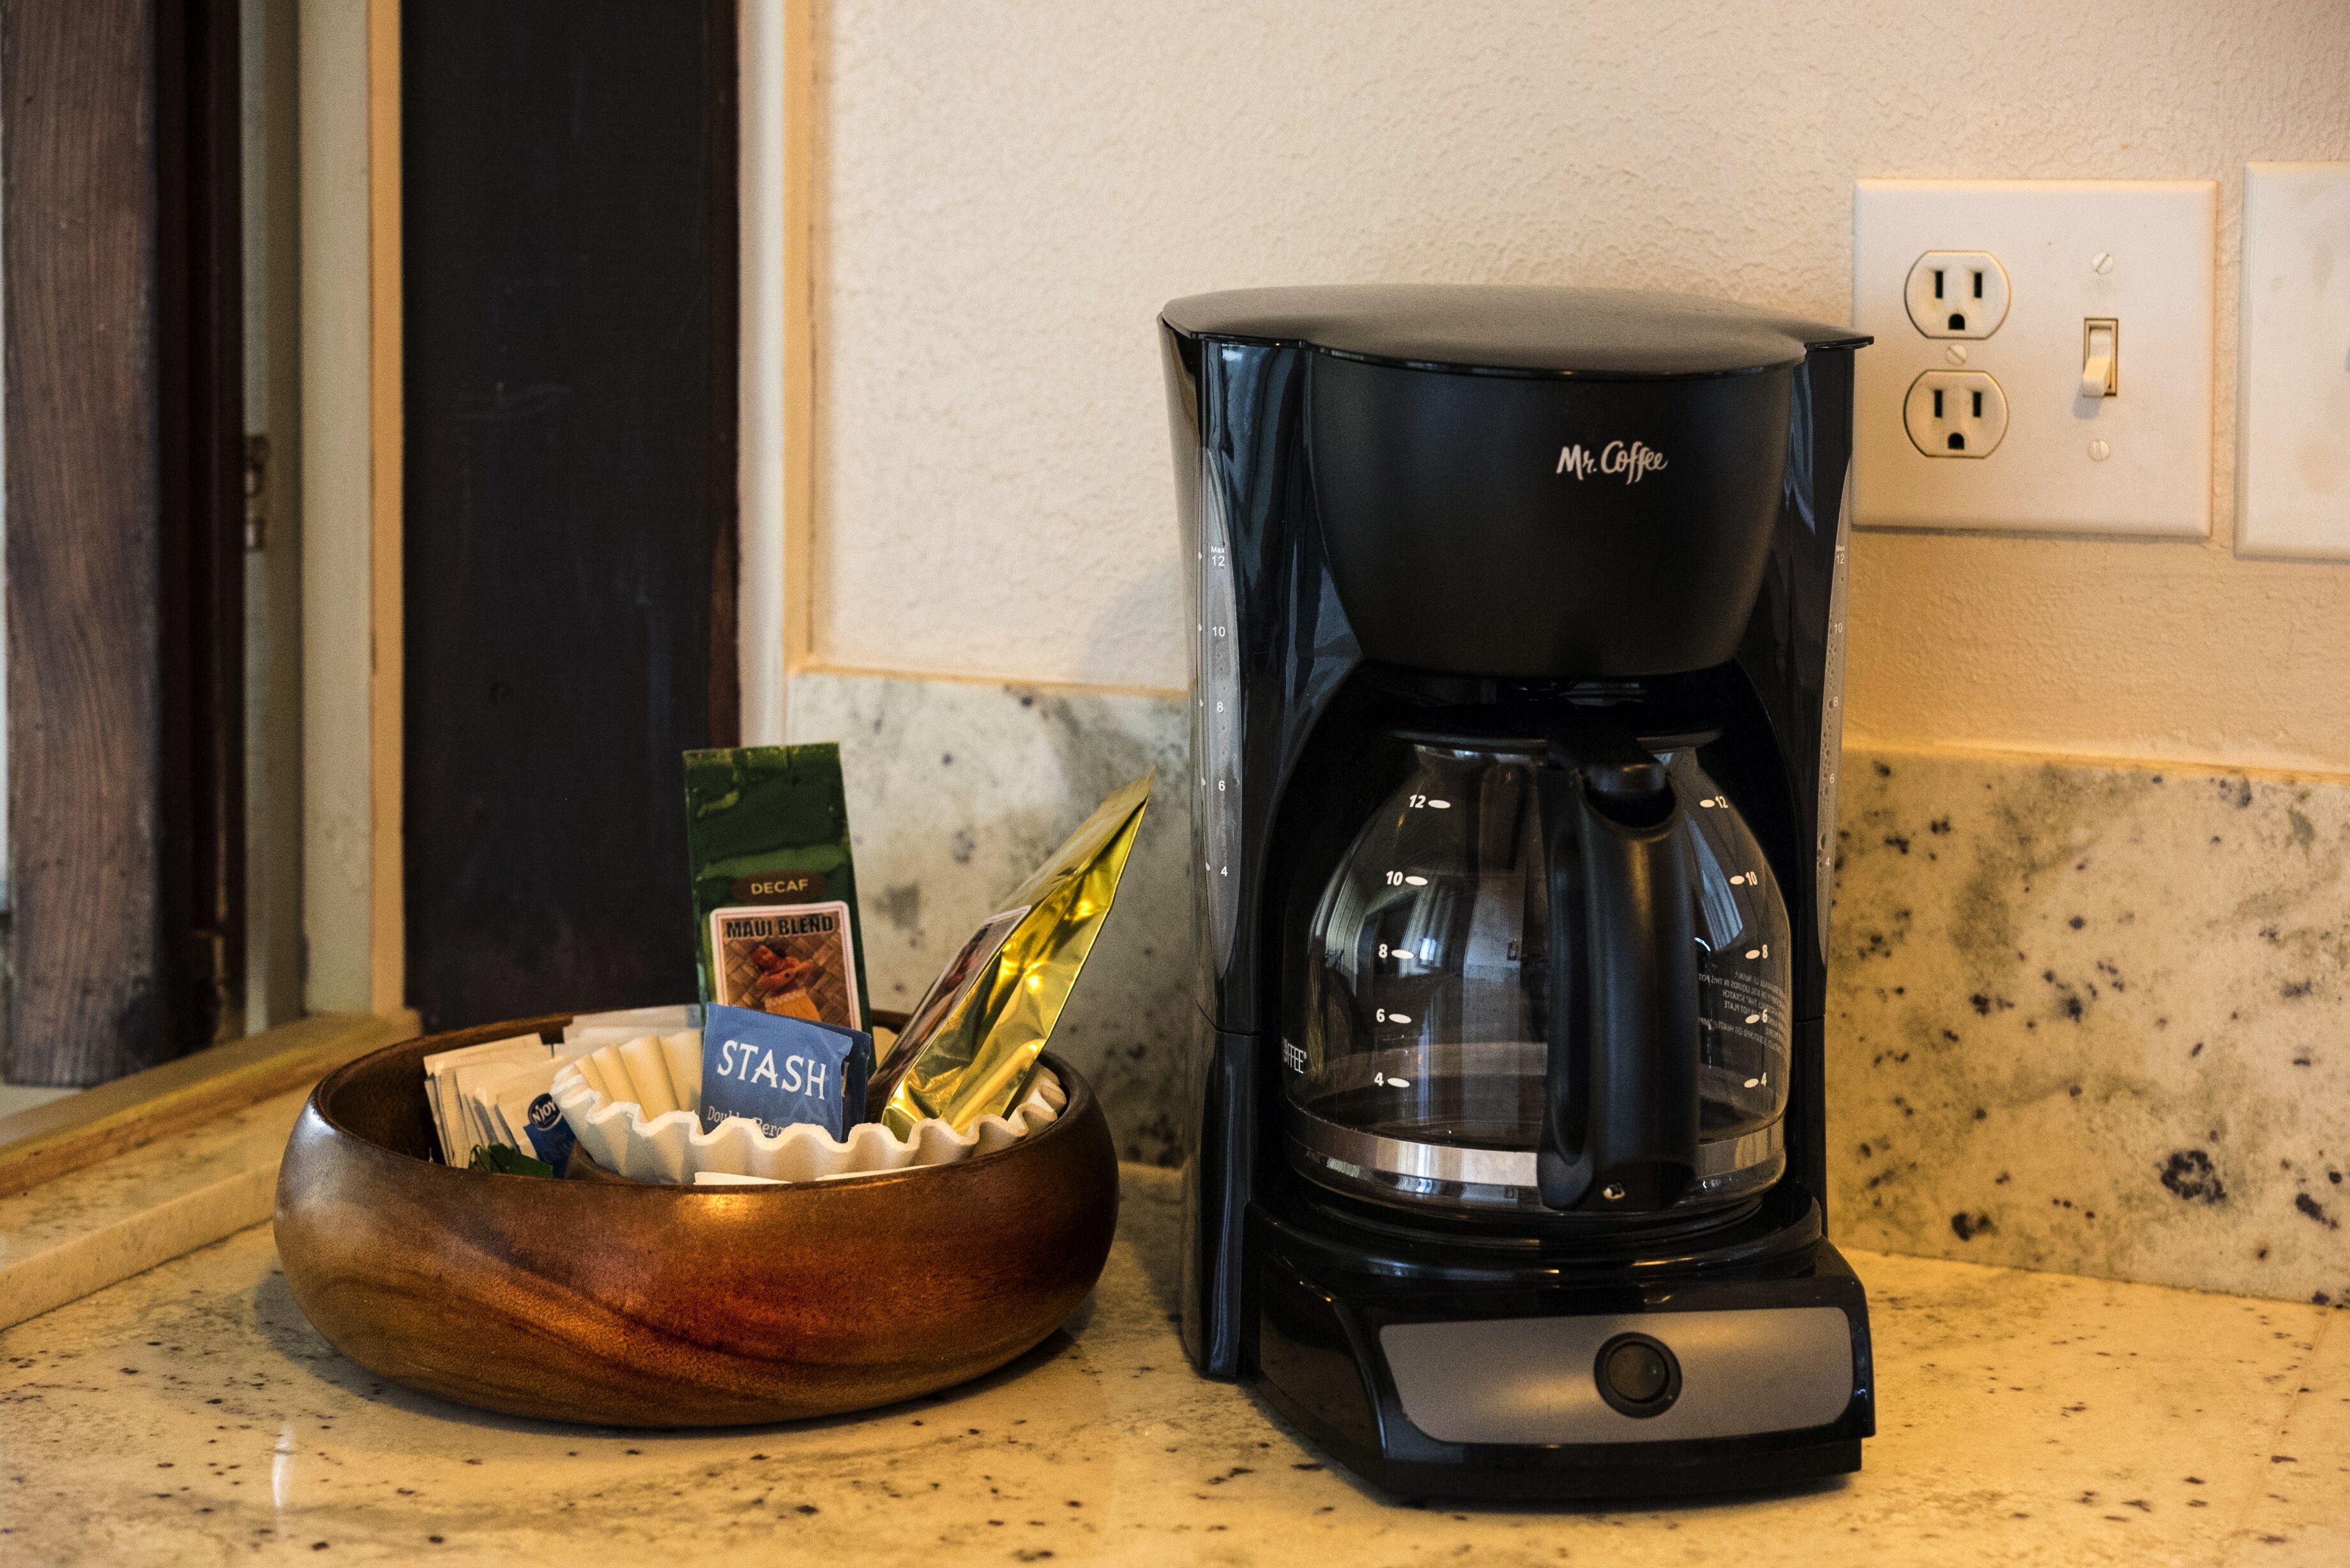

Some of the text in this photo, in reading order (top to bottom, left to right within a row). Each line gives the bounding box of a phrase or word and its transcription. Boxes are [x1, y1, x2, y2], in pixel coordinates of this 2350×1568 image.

[1556, 441, 1669, 485] Mr. Coffee
[1211, 555, 1225, 566] 12
[1837, 554, 1845, 564] 12
[1212, 626, 1225, 637] 10
[1835, 622, 1842, 633] 10
[1217, 702, 1224, 712] 8
[1833, 696, 1838, 707] 8
[1830, 773, 1835, 783] 6
[1218, 780, 1225, 791] 6
[1409, 794, 1427, 809] 12
[1715, 795, 1729, 809] 12
[1825, 857, 1830, 867] 4
[1220, 866, 1228, 877] 4
[1386, 870, 1404, 886] 10
[1745, 871, 1757, 886] 10
[750, 878, 808, 895] DECAF
[727, 916, 833, 938] MAUI BLEND
[1378, 944, 1388, 958] 8
[1762, 944, 1768, 959] 8
[1376, 1008, 1386, 1023] 6
[1762, 1009, 1768, 1023] 6
[717, 1040, 826, 1100] STASH
[1374, 1072, 1384, 1087] 4
[1761, 1072, 1767, 1087] 4
